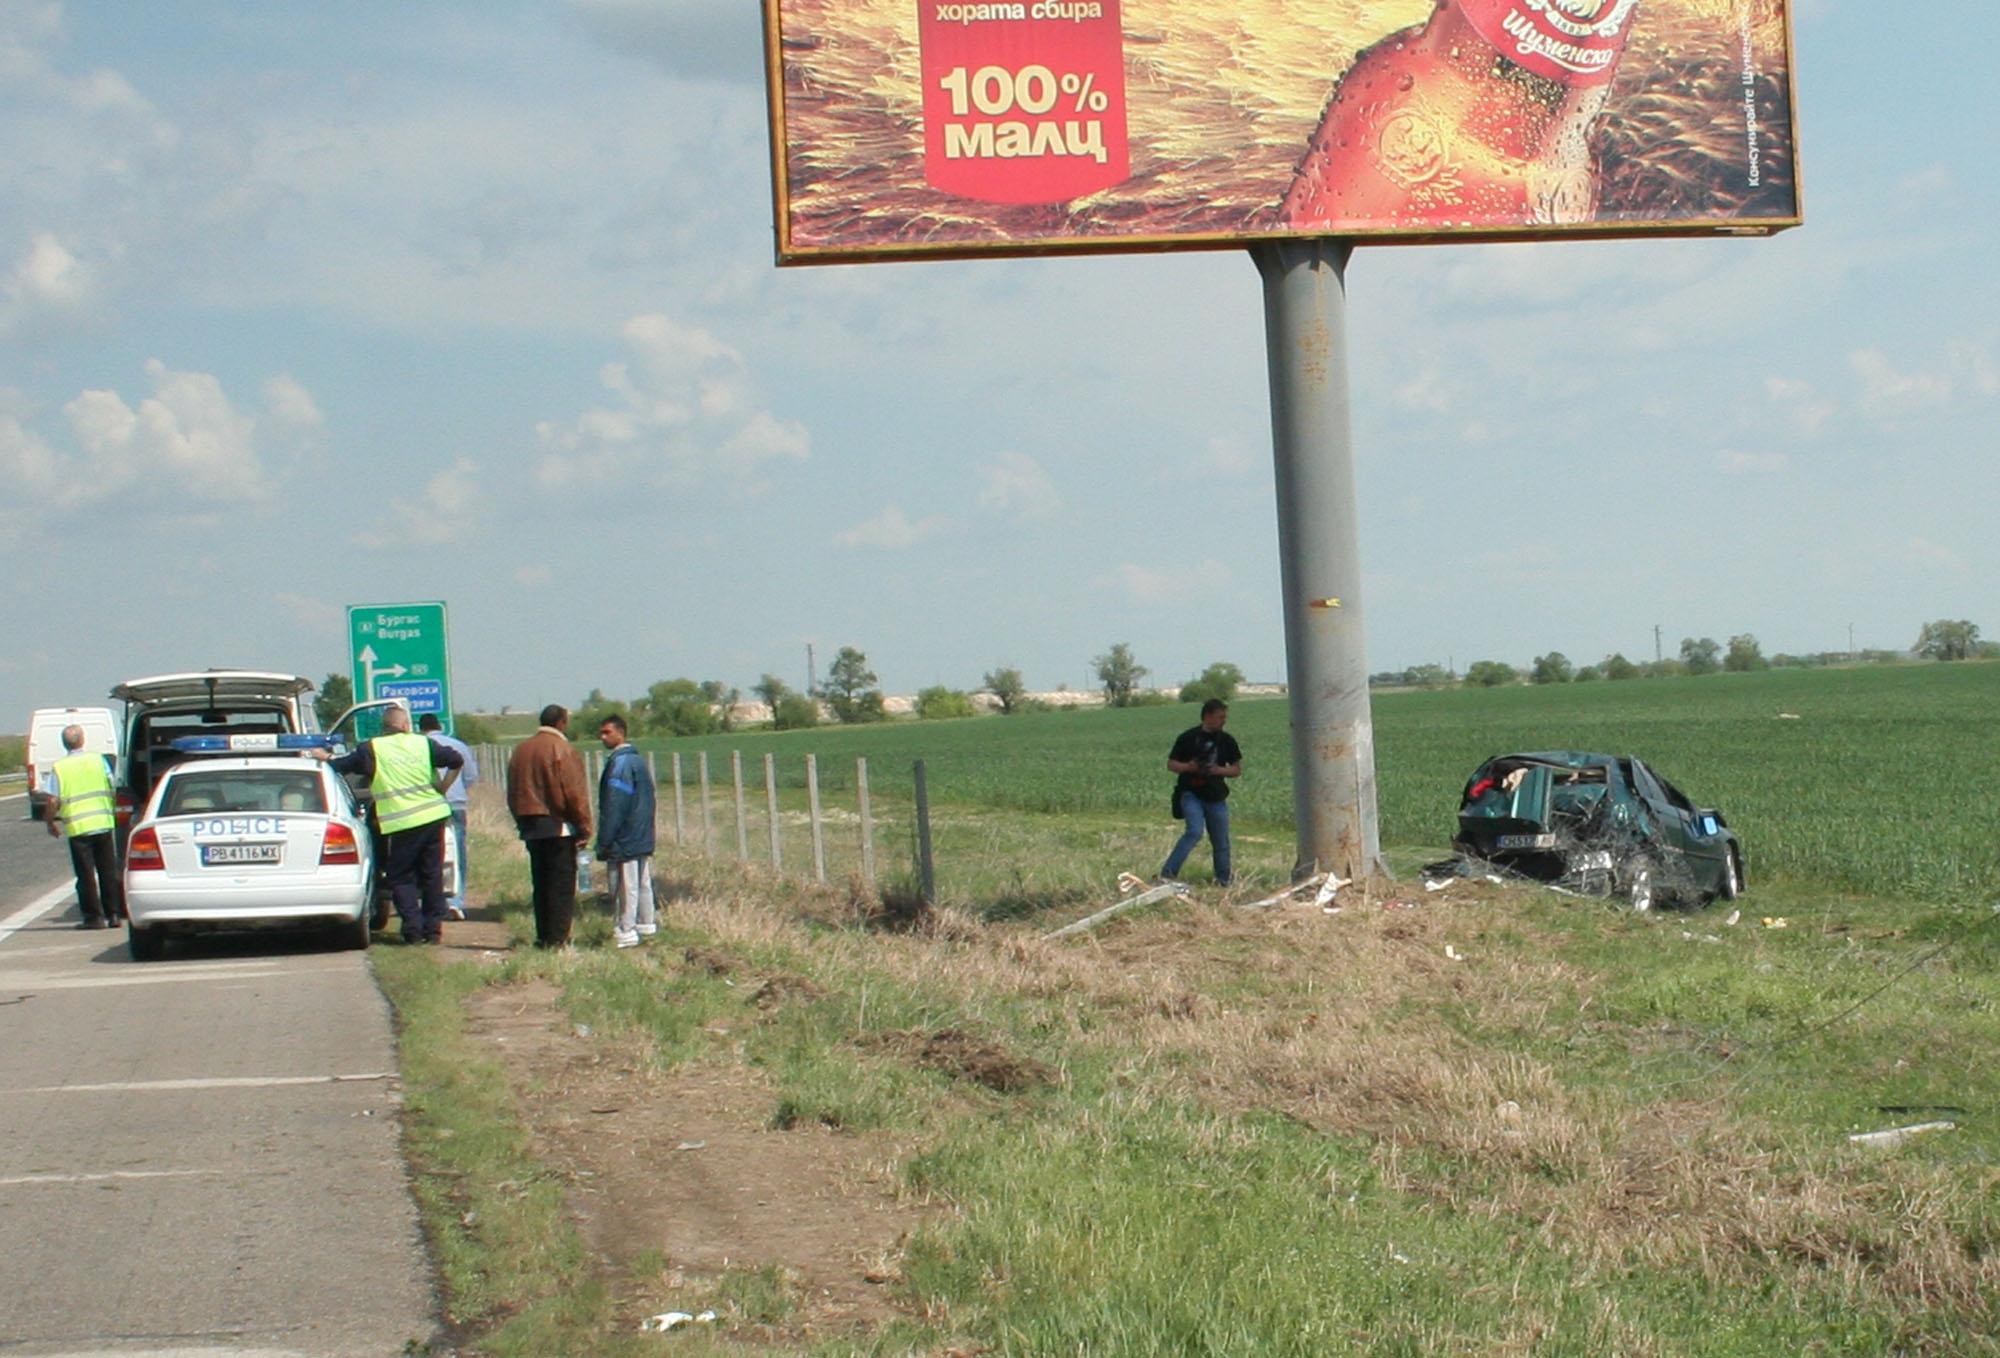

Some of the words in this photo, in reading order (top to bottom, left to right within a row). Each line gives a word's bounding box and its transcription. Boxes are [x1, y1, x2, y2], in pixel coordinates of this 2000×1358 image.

[936, 4, 1025, 25] хората
[1031, 0, 1102, 23] сбира
[1502, 8, 1614, 72] Шуменско
[940, 65, 1108, 115] 100%
[944, 120, 1107, 163] малц
[377, 614, 420, 628] Бургас
[378, 628, 421, 640] Burgas
[382, 686, 439, 697] Раковски
[233, 736, 275, 747] POLICE
[193, 817, 287, 837] POLICE
